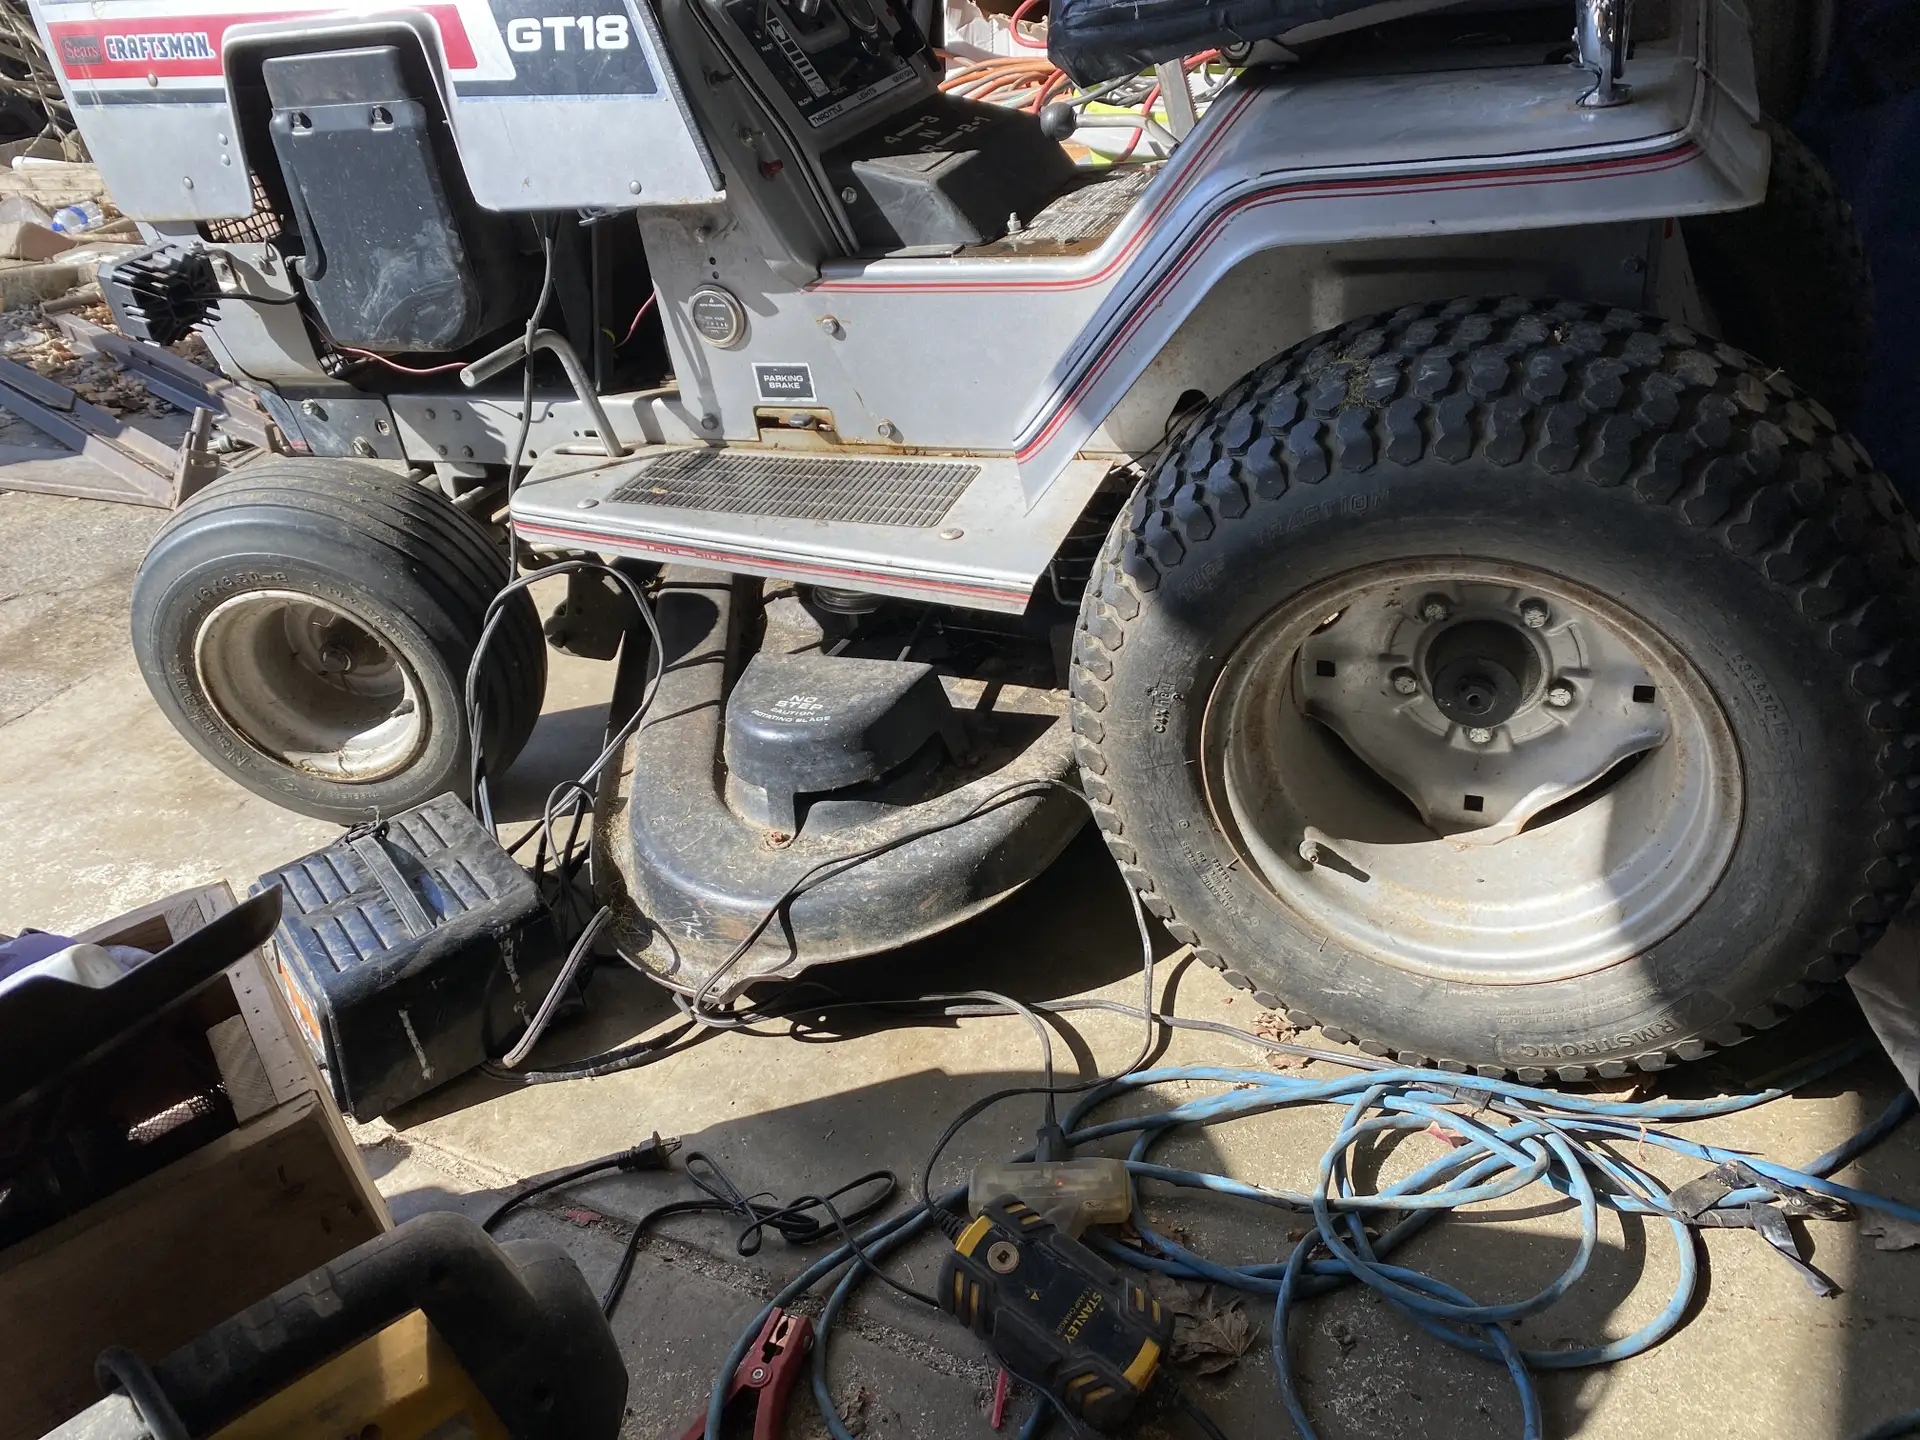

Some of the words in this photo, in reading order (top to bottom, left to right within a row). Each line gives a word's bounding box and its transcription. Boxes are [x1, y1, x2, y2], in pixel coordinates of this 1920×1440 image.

[506, 15, 629, 52] GT18
[64, 41, 98, 57] Sears
[105, 33, 209, 60] CRAFTSMAN
[812, 105, 843, 125] THROTTLE
[763, 374, 803, 382] PARKING
[775, 700, 824, 710] STEP
[790, 695, 818, 703] NO
[751, 709, 793, 722] ROTATING
[770, 707, 815, 716] CAUTION
[1055, 1307, 1076, 1335] CHARGER
[1064, 1292, 1102, 1344] STANLEY
